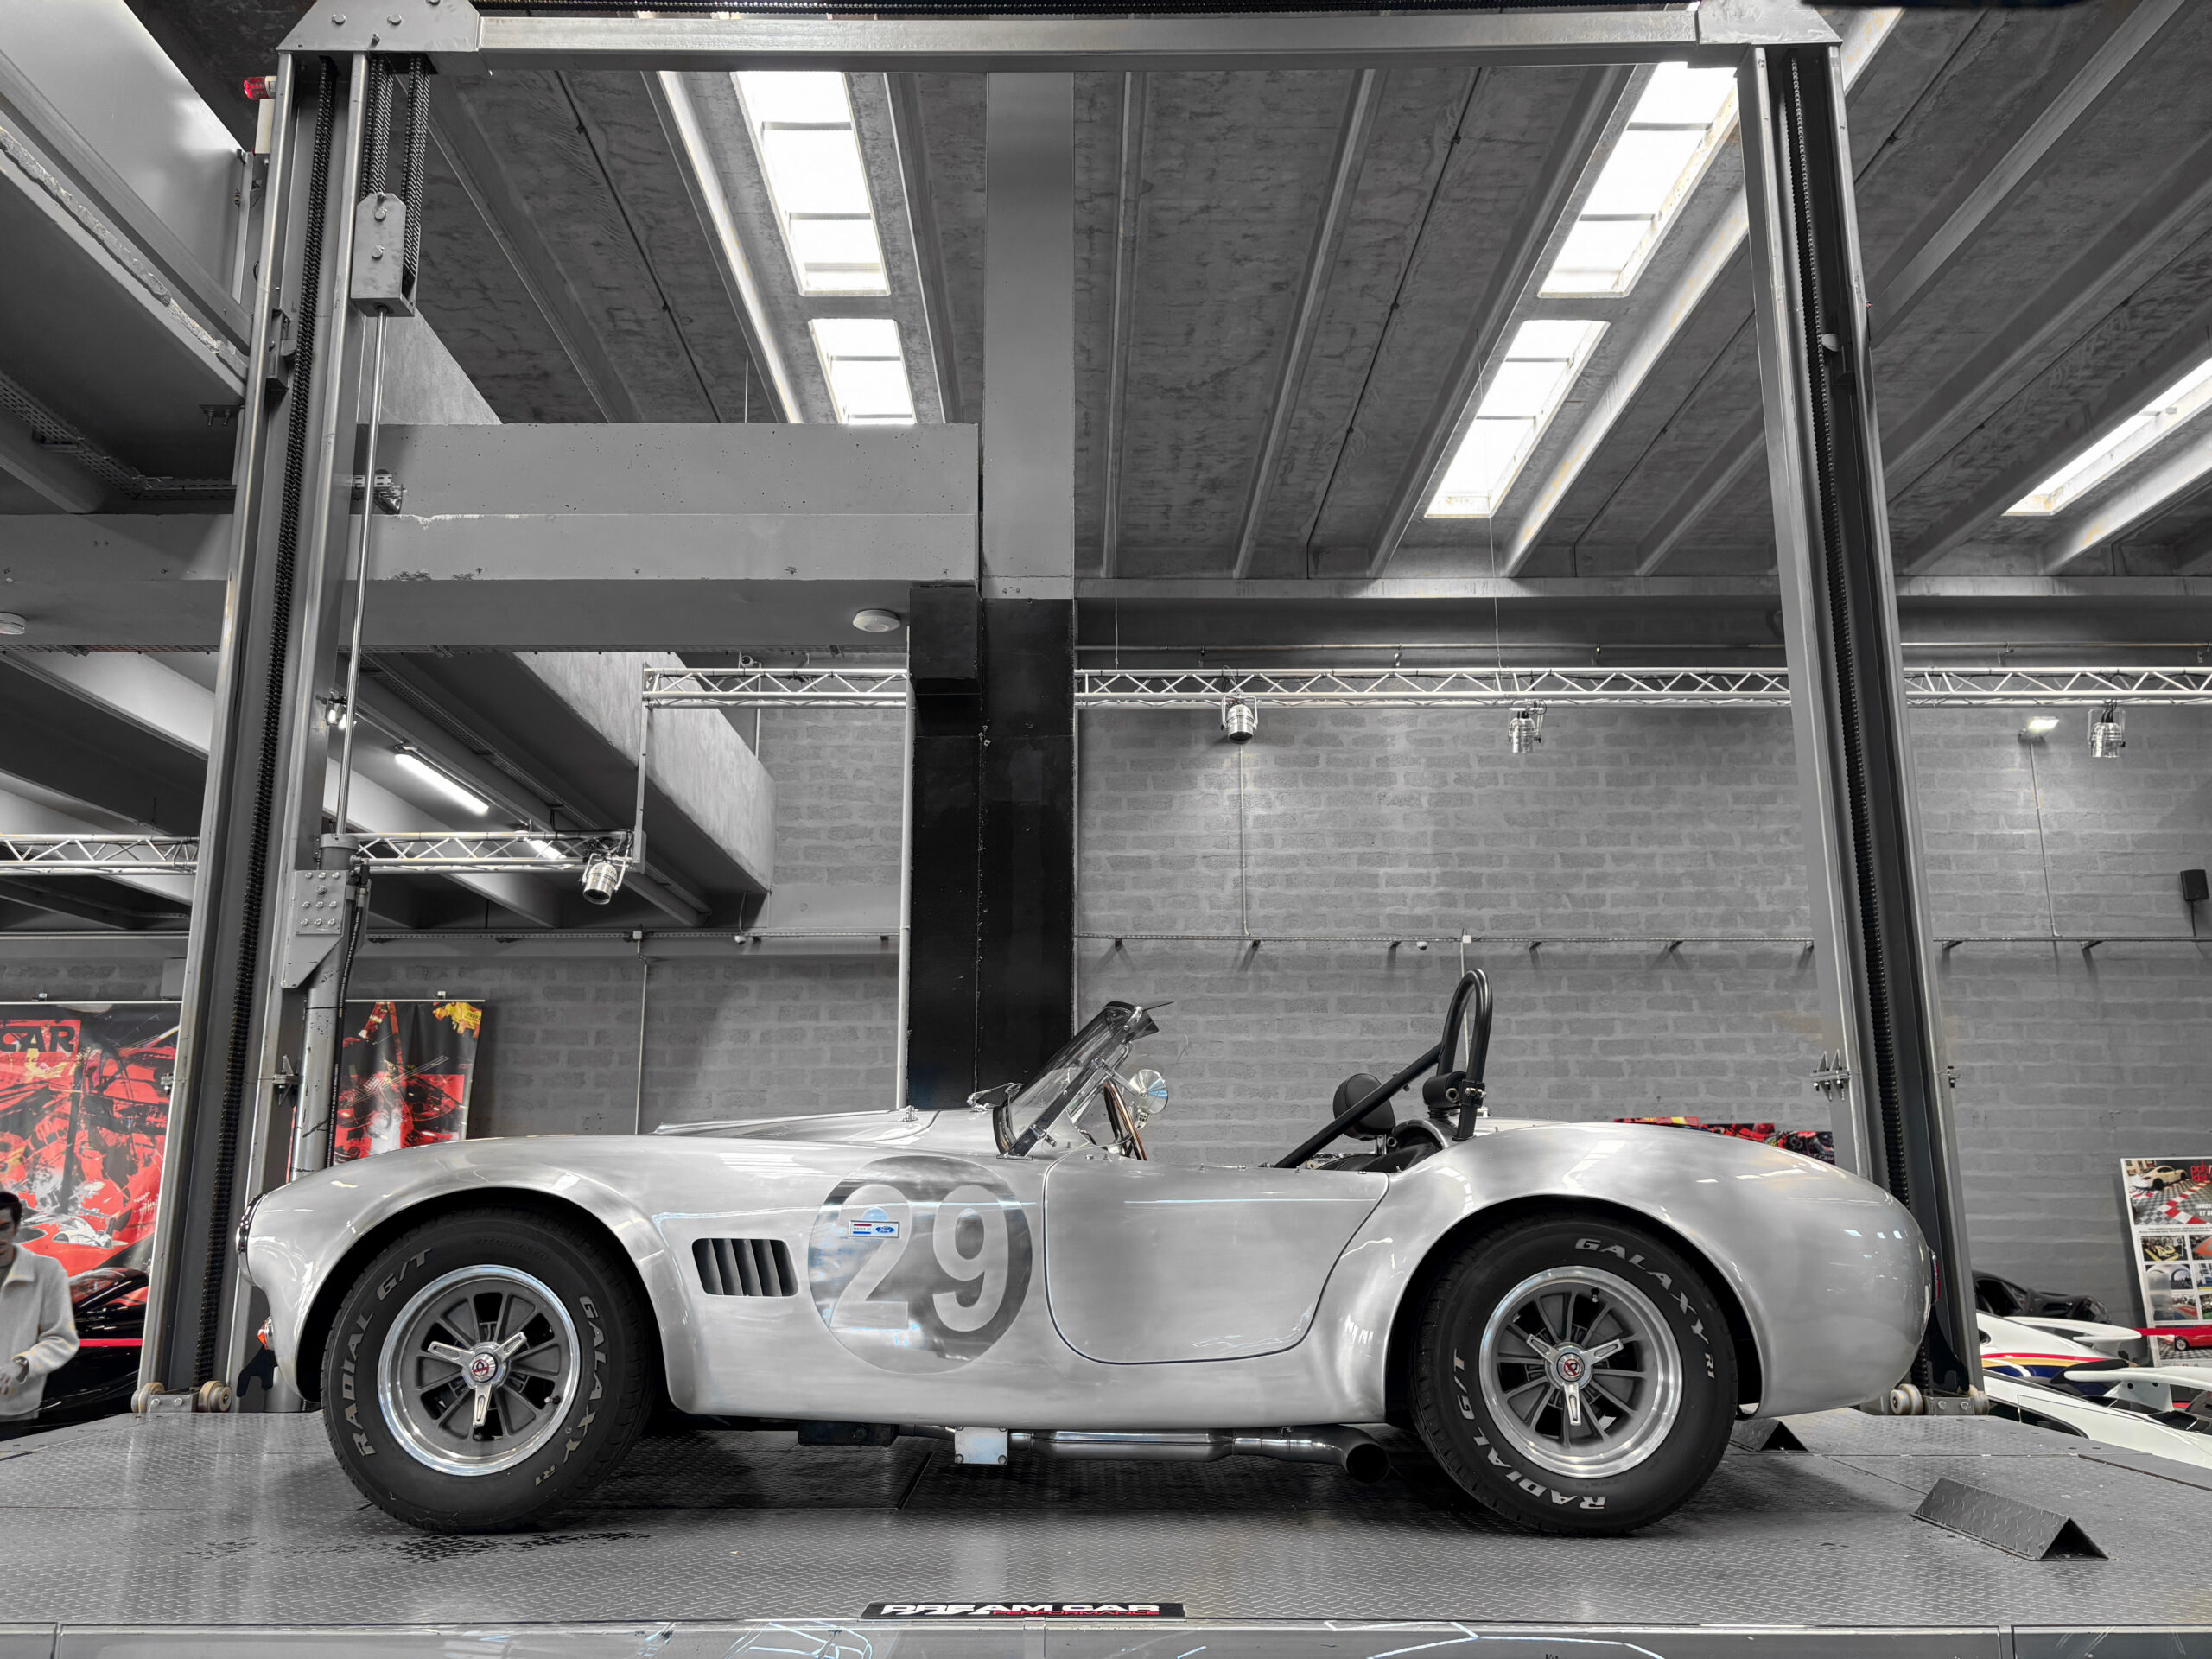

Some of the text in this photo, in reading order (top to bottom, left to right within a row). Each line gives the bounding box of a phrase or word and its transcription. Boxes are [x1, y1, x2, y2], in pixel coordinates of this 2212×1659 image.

[830, 1184, 1009, 1332] 29
[1574, 1237, 1710, 1345] GALAXY
[341, 1248, 433, 1458] RADIAL G/T
[563, 1296, 607, 1463] GALAXY
[1453, 1348, 1607, 1510] RADIAL G/T
[880, 1605, 1053, 1615] DREAM
